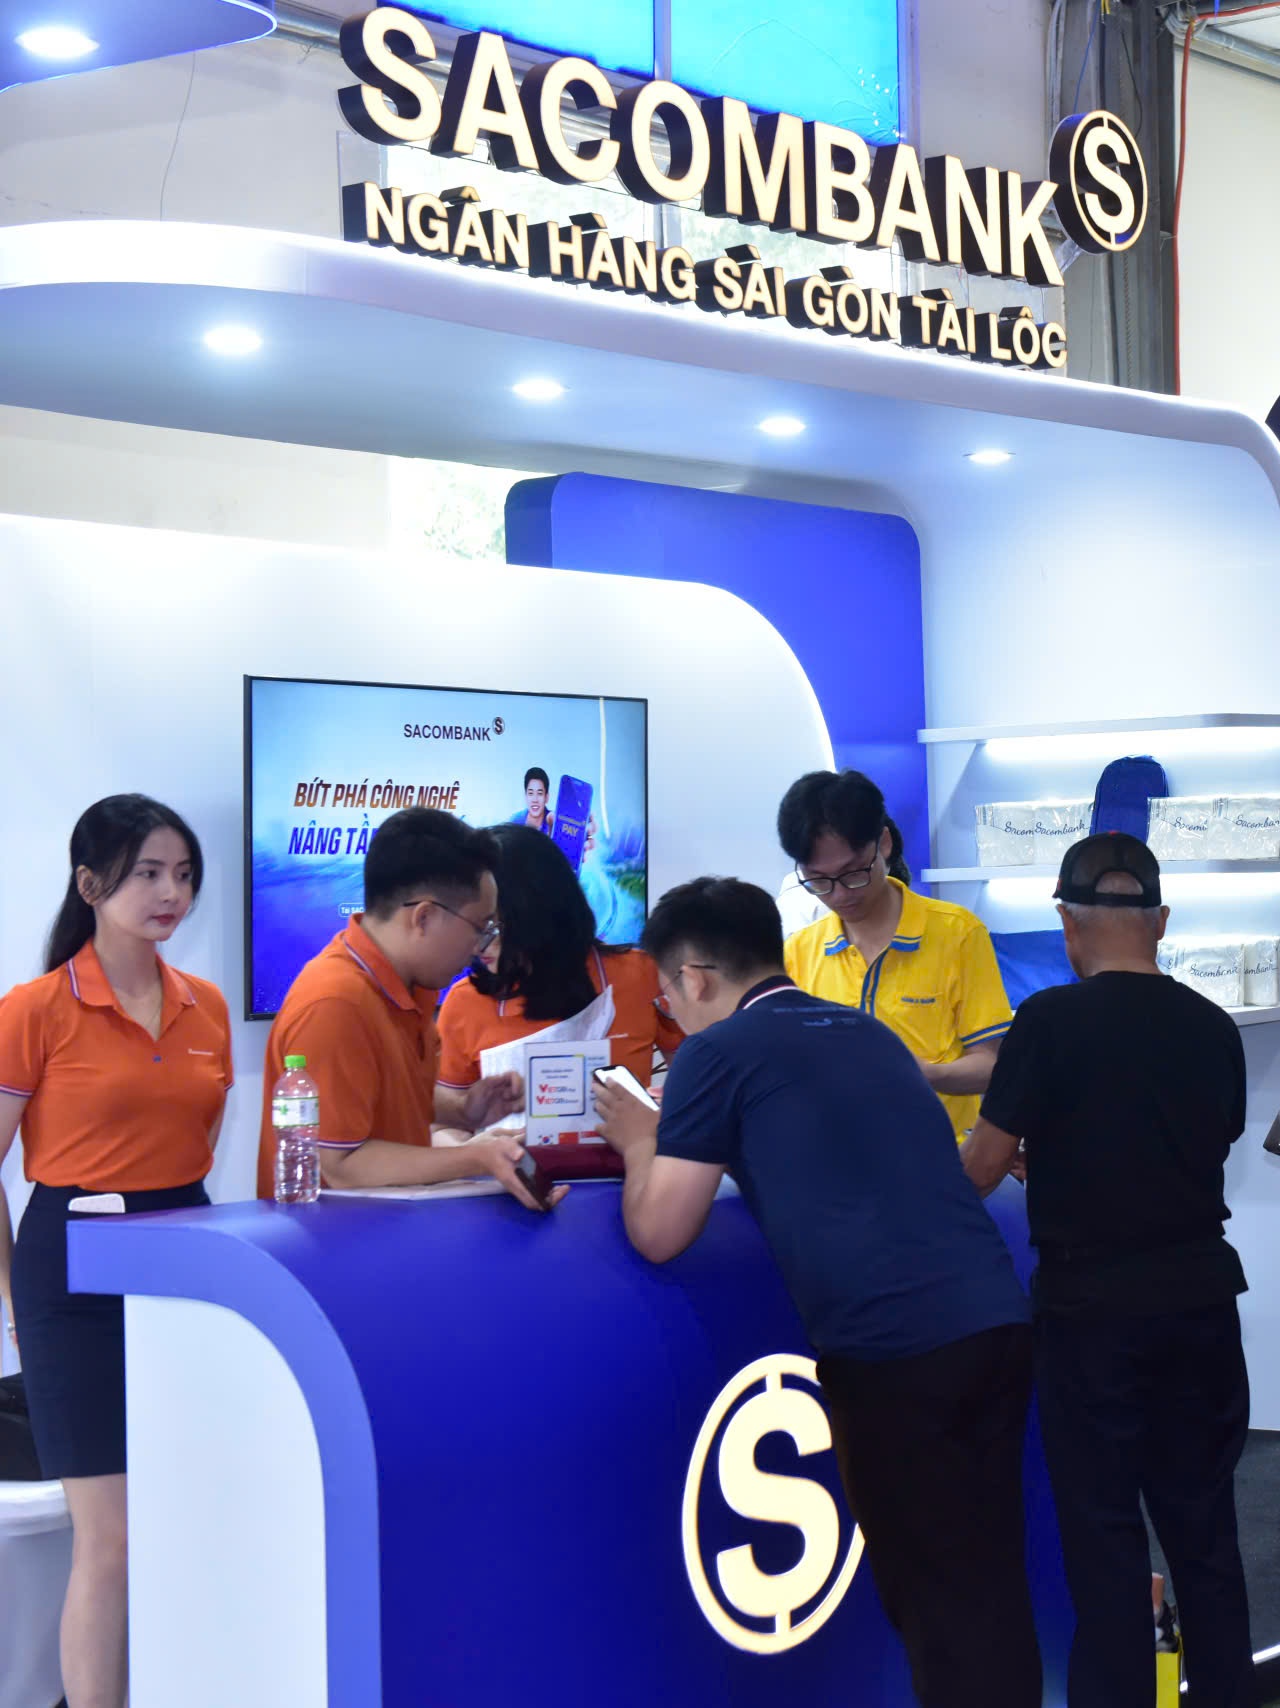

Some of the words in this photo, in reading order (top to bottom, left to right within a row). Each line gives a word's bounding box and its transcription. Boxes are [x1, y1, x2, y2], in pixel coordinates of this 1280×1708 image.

[358, 5, 1063, 286] SACOMBANK
[360, 181, 529, 268] NGÂN
[547, 212, 696, 301] HÀNG
[713, 244, 786, 317] SÀI
[803, 266, 898, 339] GÒN
[911, 288, 975, 353] TÀI
[403, 723, 491, 741] SACOMBANK
[293, 776, 332, 808] BỨT
[331, 778, 369, 808] PHÁ
[370, 779, 415, 809] CÔNG
[288, 820, 342, 855] NÂNG
[345, 812, 380, 855] TẦ
[1034, 818, 1087, 836] Sacombank
